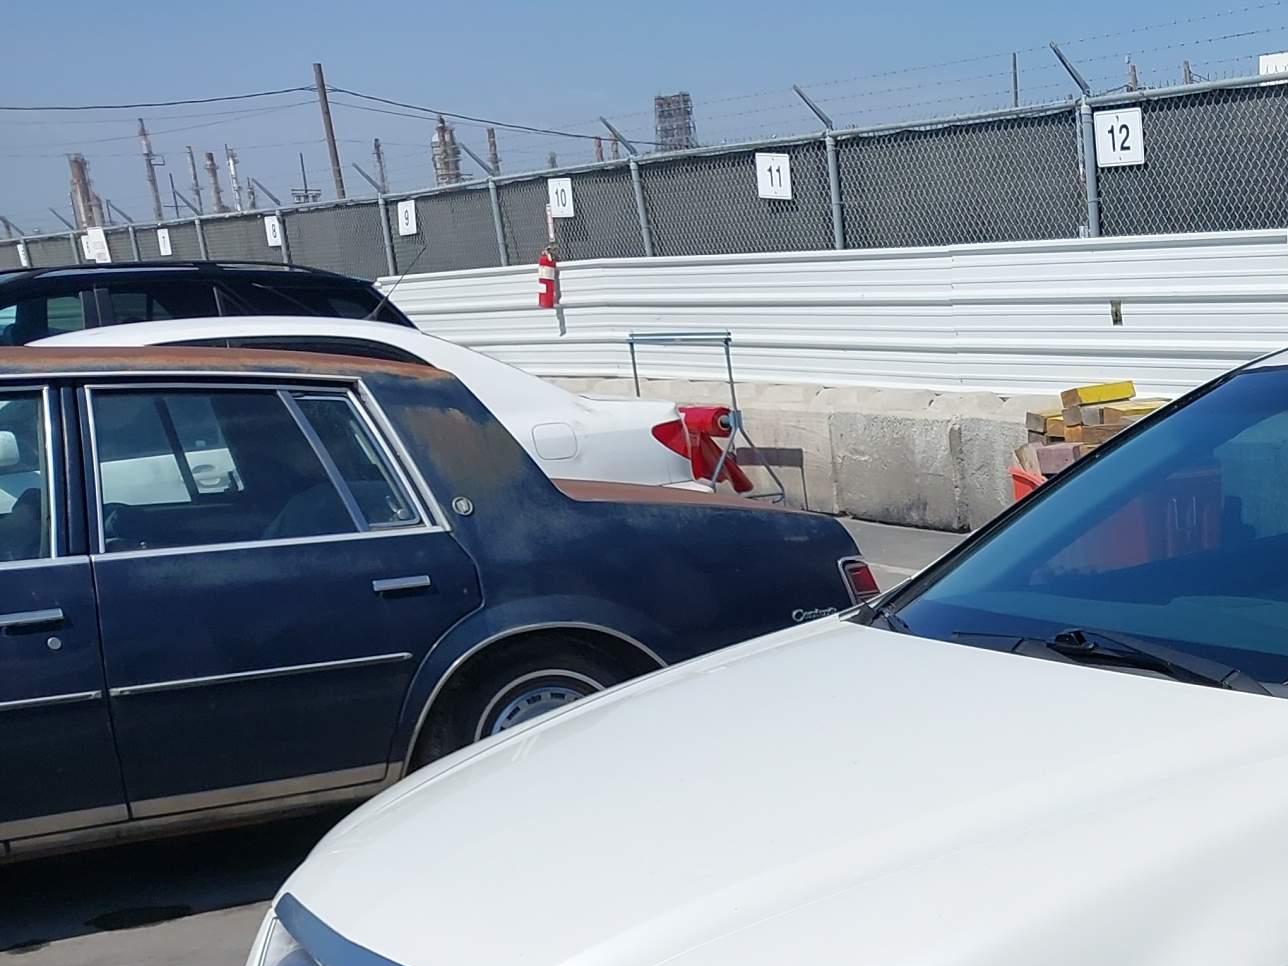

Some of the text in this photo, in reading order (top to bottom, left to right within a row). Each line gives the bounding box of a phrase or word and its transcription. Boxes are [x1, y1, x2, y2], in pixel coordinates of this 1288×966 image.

[1107, 123, 1131, 152] 12
[767, 165, 782, 188] 11
[555, 188, 567, 208] 10
[404, 209, 410, 226] 9
